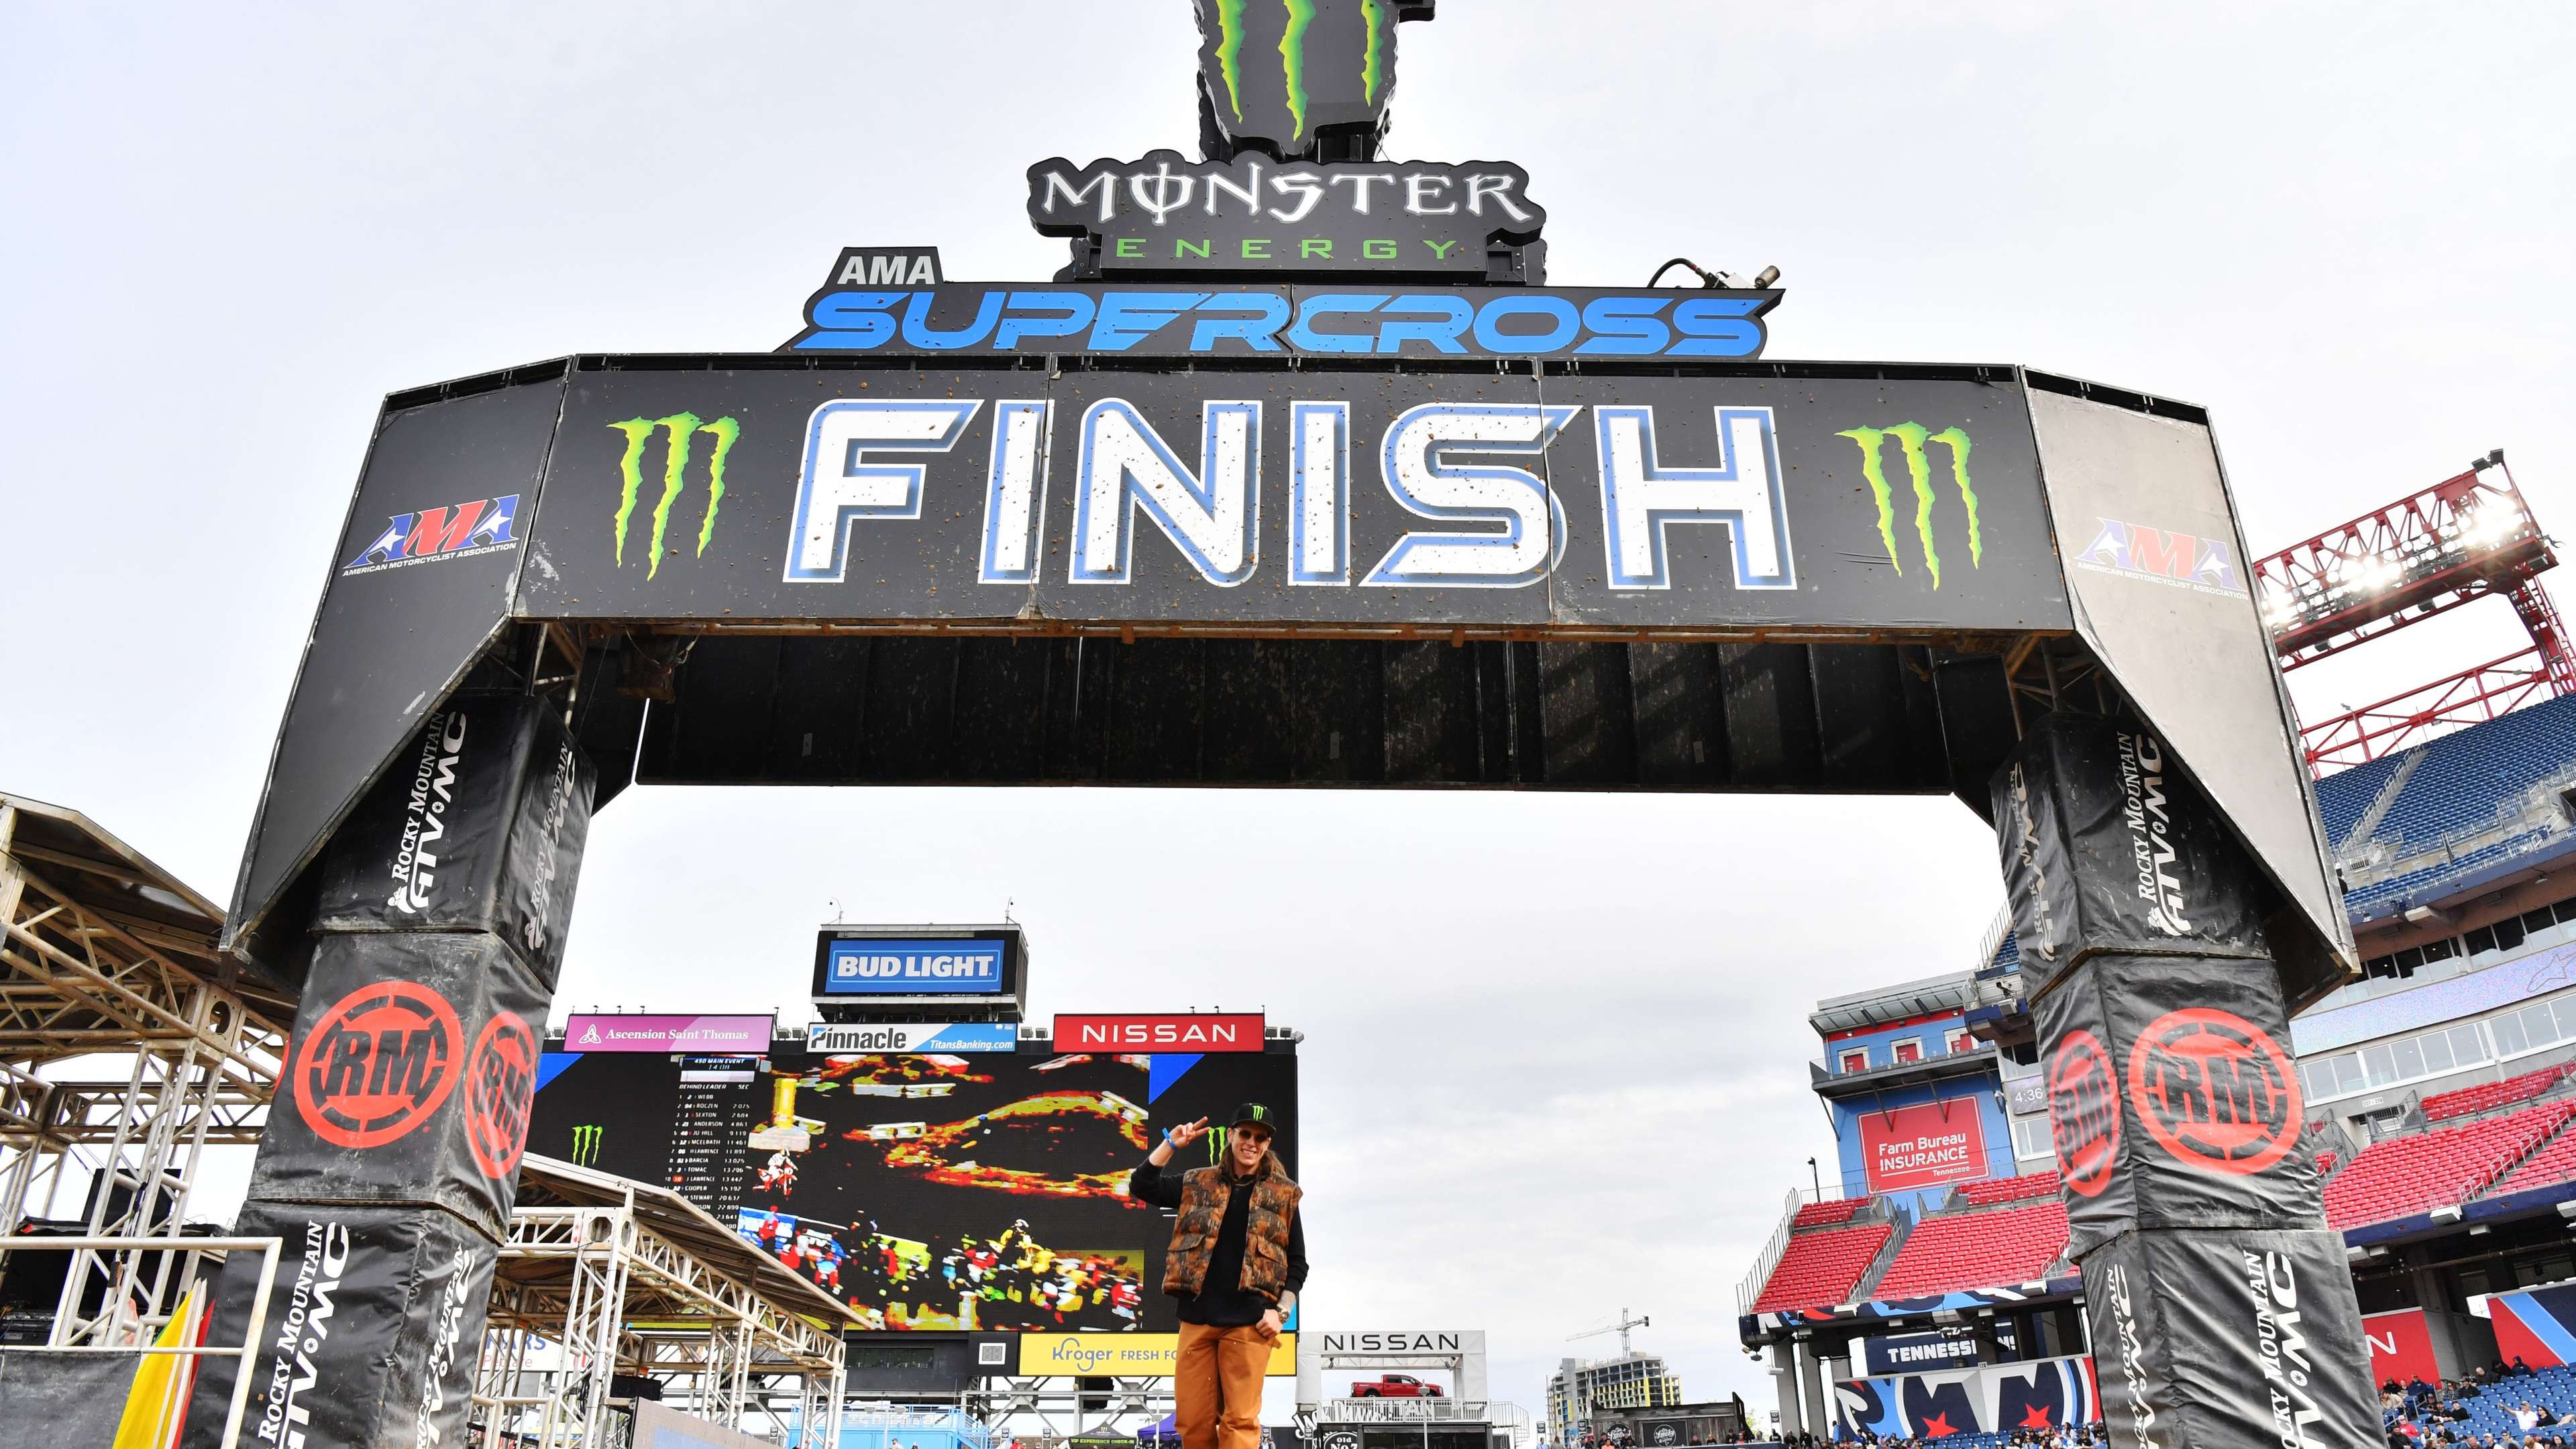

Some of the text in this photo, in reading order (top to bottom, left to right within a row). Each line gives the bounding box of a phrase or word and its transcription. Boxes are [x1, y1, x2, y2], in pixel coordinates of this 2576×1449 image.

[1040, 158, 1535, 225] MONSTER
[1116, 238, 1459, 262] ENERGY
[837, 256, 937, 286] AMA
[793, 291, 1767, 357] SUPERCROSS
[782, 397, 1799, 592] FINISH
[343, 493, 520, 570] AMA
[342, 542, 517, 577] AMERICAN MOTORCYCLIST ASSOCIATION
[2074, 516, 2249, 592] AMA
[2077, 561, 2249, 601] AMERICAN MOTORCYCLIST ASSOCIATION
[392, 712, 445, 883] ROCKY MOUNTAIN
[531, 740, 568, 912] ROCKY MOUNTAIN
[2117, 731, 2158, 904] ROCKY MOUNTAIN
[837, 955, 994, 977] BUD LIGHT
[604, 1028, 749, 1040] Ascension Saint Thomas
[811, 1026, 907, 1050] Pinnacle
[930, 1039, 1014, 1053] TitansBanking.com
[1081, 1024, 1236, 1043] NISSAN
[2015, 1087, 2043, 1103] 4:36
[1878, 1132, 1966, 1156] Farm Bureau
[1880, 1146, 1969, 1172] INSURANCE
[1932, 1166, 1970, 1177] Tennessee
[427, 1243, 464, 1375] MOUNTAIN
[258, 1219, 325, 1444] ROCKY MOUNTAIN
[1324, 1334, 1458, 1350] NISSAN
[2107, 1267, 2139, 1395] MOUNTAIN
[2243, 1249, 2300, 1449] OCKY MOUNTAIN
[1052, 1337, 1114, 1373] Kroger
[1121, 1350, 1160, 1360] FRESH
